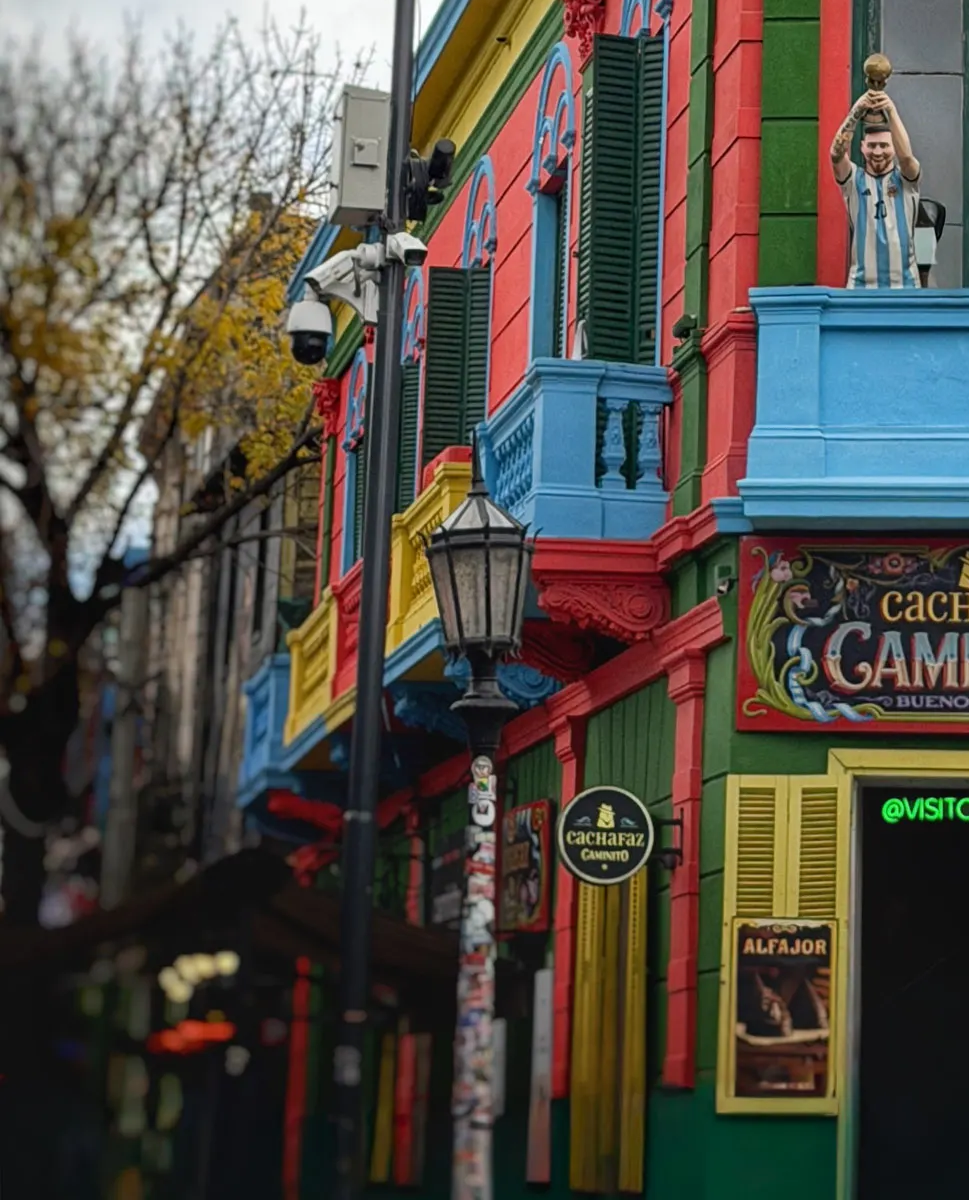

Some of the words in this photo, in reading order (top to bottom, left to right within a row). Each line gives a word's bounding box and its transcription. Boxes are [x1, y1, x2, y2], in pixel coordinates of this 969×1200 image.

[874, 200, 888, 219] 10
[581, 848, 629, 862] CAMINITO
[743, 938, 827, 955] ALFAJOR
